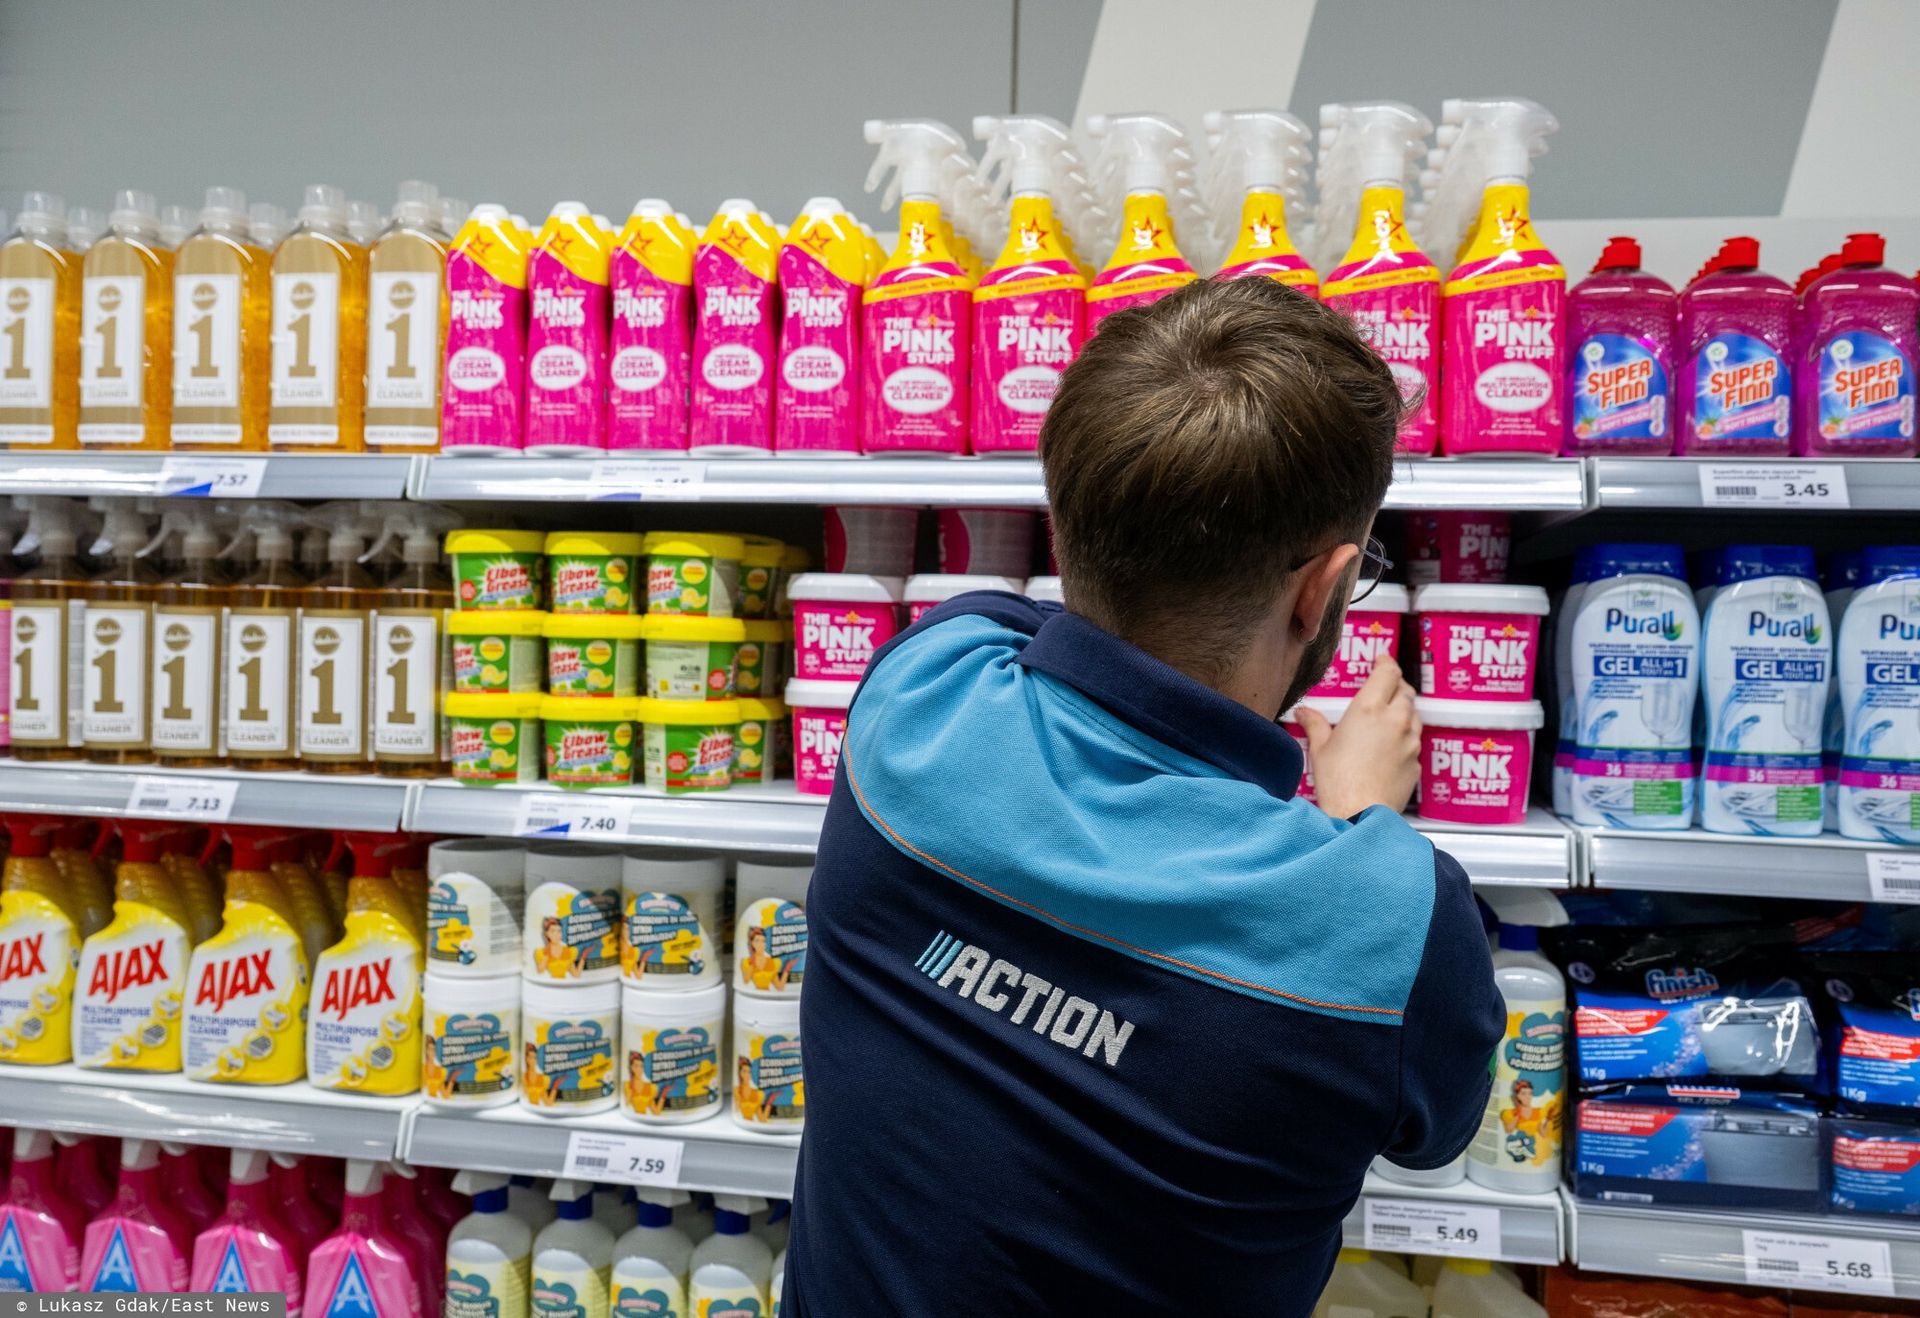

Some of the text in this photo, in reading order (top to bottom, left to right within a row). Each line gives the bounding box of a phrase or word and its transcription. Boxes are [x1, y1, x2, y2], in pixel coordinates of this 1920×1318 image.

[452, 299, 504, 320] PINK
[533, 297, 585, 319] PINK
[614, 297, 665, 319] PINK
[705, 296, 761, 316] PINK
[787, 297, 845, 318] PINK
[999, 316, 1029, 328] THE
[1476, 309, 1510, 322] THE
[884, 318, 912, 329] THE
[883, 328, 955, 352] PINK
[998, 328, 1074, 351] PINK
[1474, 322, 1555, 347] PINK
[907, 351, 955, 364] STUFF
[1024, 351, 1073, 363] STUFF
[1504, 347, 1555, 360] STUFF
[456, 361, 492, 369] CREAM
[539, 360, 573, 368] CREAM
[620, 360, 653, 368] CREAM
[713, 359, 749, 368] CREAM
[452, 370, 498, 379] CLEANER
[535, 369, 580, 378] CLEANER
[615, 370, 659, 379] CLEANER
[707, 368, 757, 377] CLEANER
[788, 370, 838, 379] CLEANER
[1587, 358, 1652, 394] SUPER
[1711, 358, 1776, 394] SUPER
[1835, 358, 1902, 393] SUPER
[892, 392, 944, 400] CLEANER
[1486, 389, 1543, 398] CLEANER
[1601, 380, 1646, 409] FINN
[1724, 380, 1771, 409] FINN
[1850, 379, 1896, 408] FINN
[1784, 483, 1829, 496] 3.45
[486, 567, 529, 582] Elbow
[487, 579, 530, 593] Grease
[803, 613, 830, 625] THE
[1605, 608, 1675, 634] Purall
[1748, 611, 1814, 637] Purall
[803, 626, 874, 649] PINK
[1450, 625, 1485, 639] THE
[1449, 639, 1528, 664] PINK
[1479, 665, 1526, 678] STUFF
[1599, 657, 1683, 676] GEL ALL in 1
[1741, 660, 1823, 680] GEL ALL in 1
[1872, 664, 1918, 684] GEL
[15, 648, 38, 710] 1
[92, 650, 123, 712] 1
[162, 656, 191, 720] 1
[238, 656, 268, 721] 1
[311, 660, 342, 724] 1
[387, 658, 415, 724] 1
[801, 718, 826, 730] THE
[563, 733, 607, 747] Elbow
[1431, 738, 1464, 753] THE
[563, 745, 608, 760] Grease
[1431, 751, 1512, 779] PINK
[1606, 763, 1622, 776] 36
[1747, 768, 1765, 782] 36
[1880, 775, 1898, 788] 36
[1458, 778, 1511, 792] STUFF
[187, 797, 220, 810] 7.13
[581, 817, 616, 830] 7.40
[88, 939, 169, 1003] AJAX
[195, 949, 276, 1013] AJAX
[1646, 968, 1719, 995] finish
[320, 957, 396, 1022] AJAX
[82, 1004, 150, 1016] MULTIPURPOSE
[937, 944, 1136, 1067] ACTION
[82, 1015, 121, 1025] CLEANER
[189, 1014, 257, 1028] MULTIPURPOSE
[189, 1025, 227, 1036] CLEANER
[315, 1022, 378, 1037] MULTIPURPOSE
[315, 1033, 351, 1044] CLEANER
[630, 1157, 665, 1173] 7.59
[1438, 1226, 1478, 1242] 5.49
[1826, 1260, 1872, 1278] 5.68
[334, 1267, 370, 1313] A
